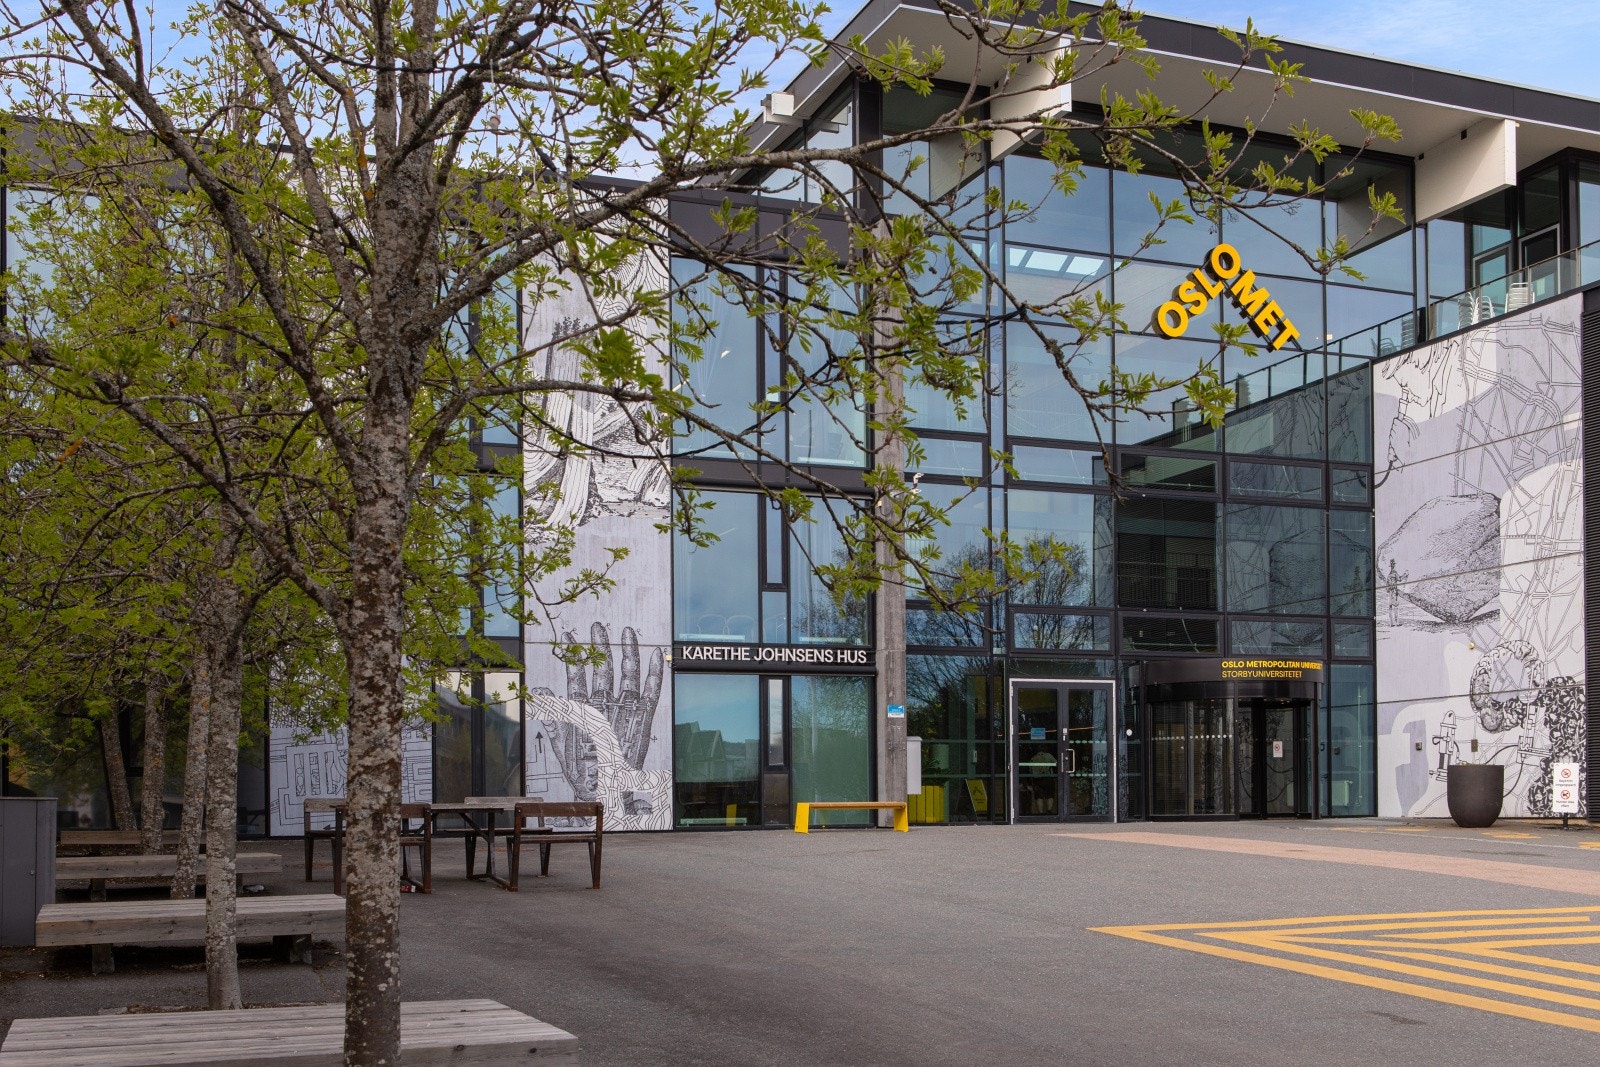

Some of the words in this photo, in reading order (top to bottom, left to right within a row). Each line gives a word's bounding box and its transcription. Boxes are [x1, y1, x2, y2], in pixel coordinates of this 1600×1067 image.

[682, 646, 750, 661] KARETHE
[754, 647, 833, 663] JOHNSENS
[837, 650, 867, 664] HUS
